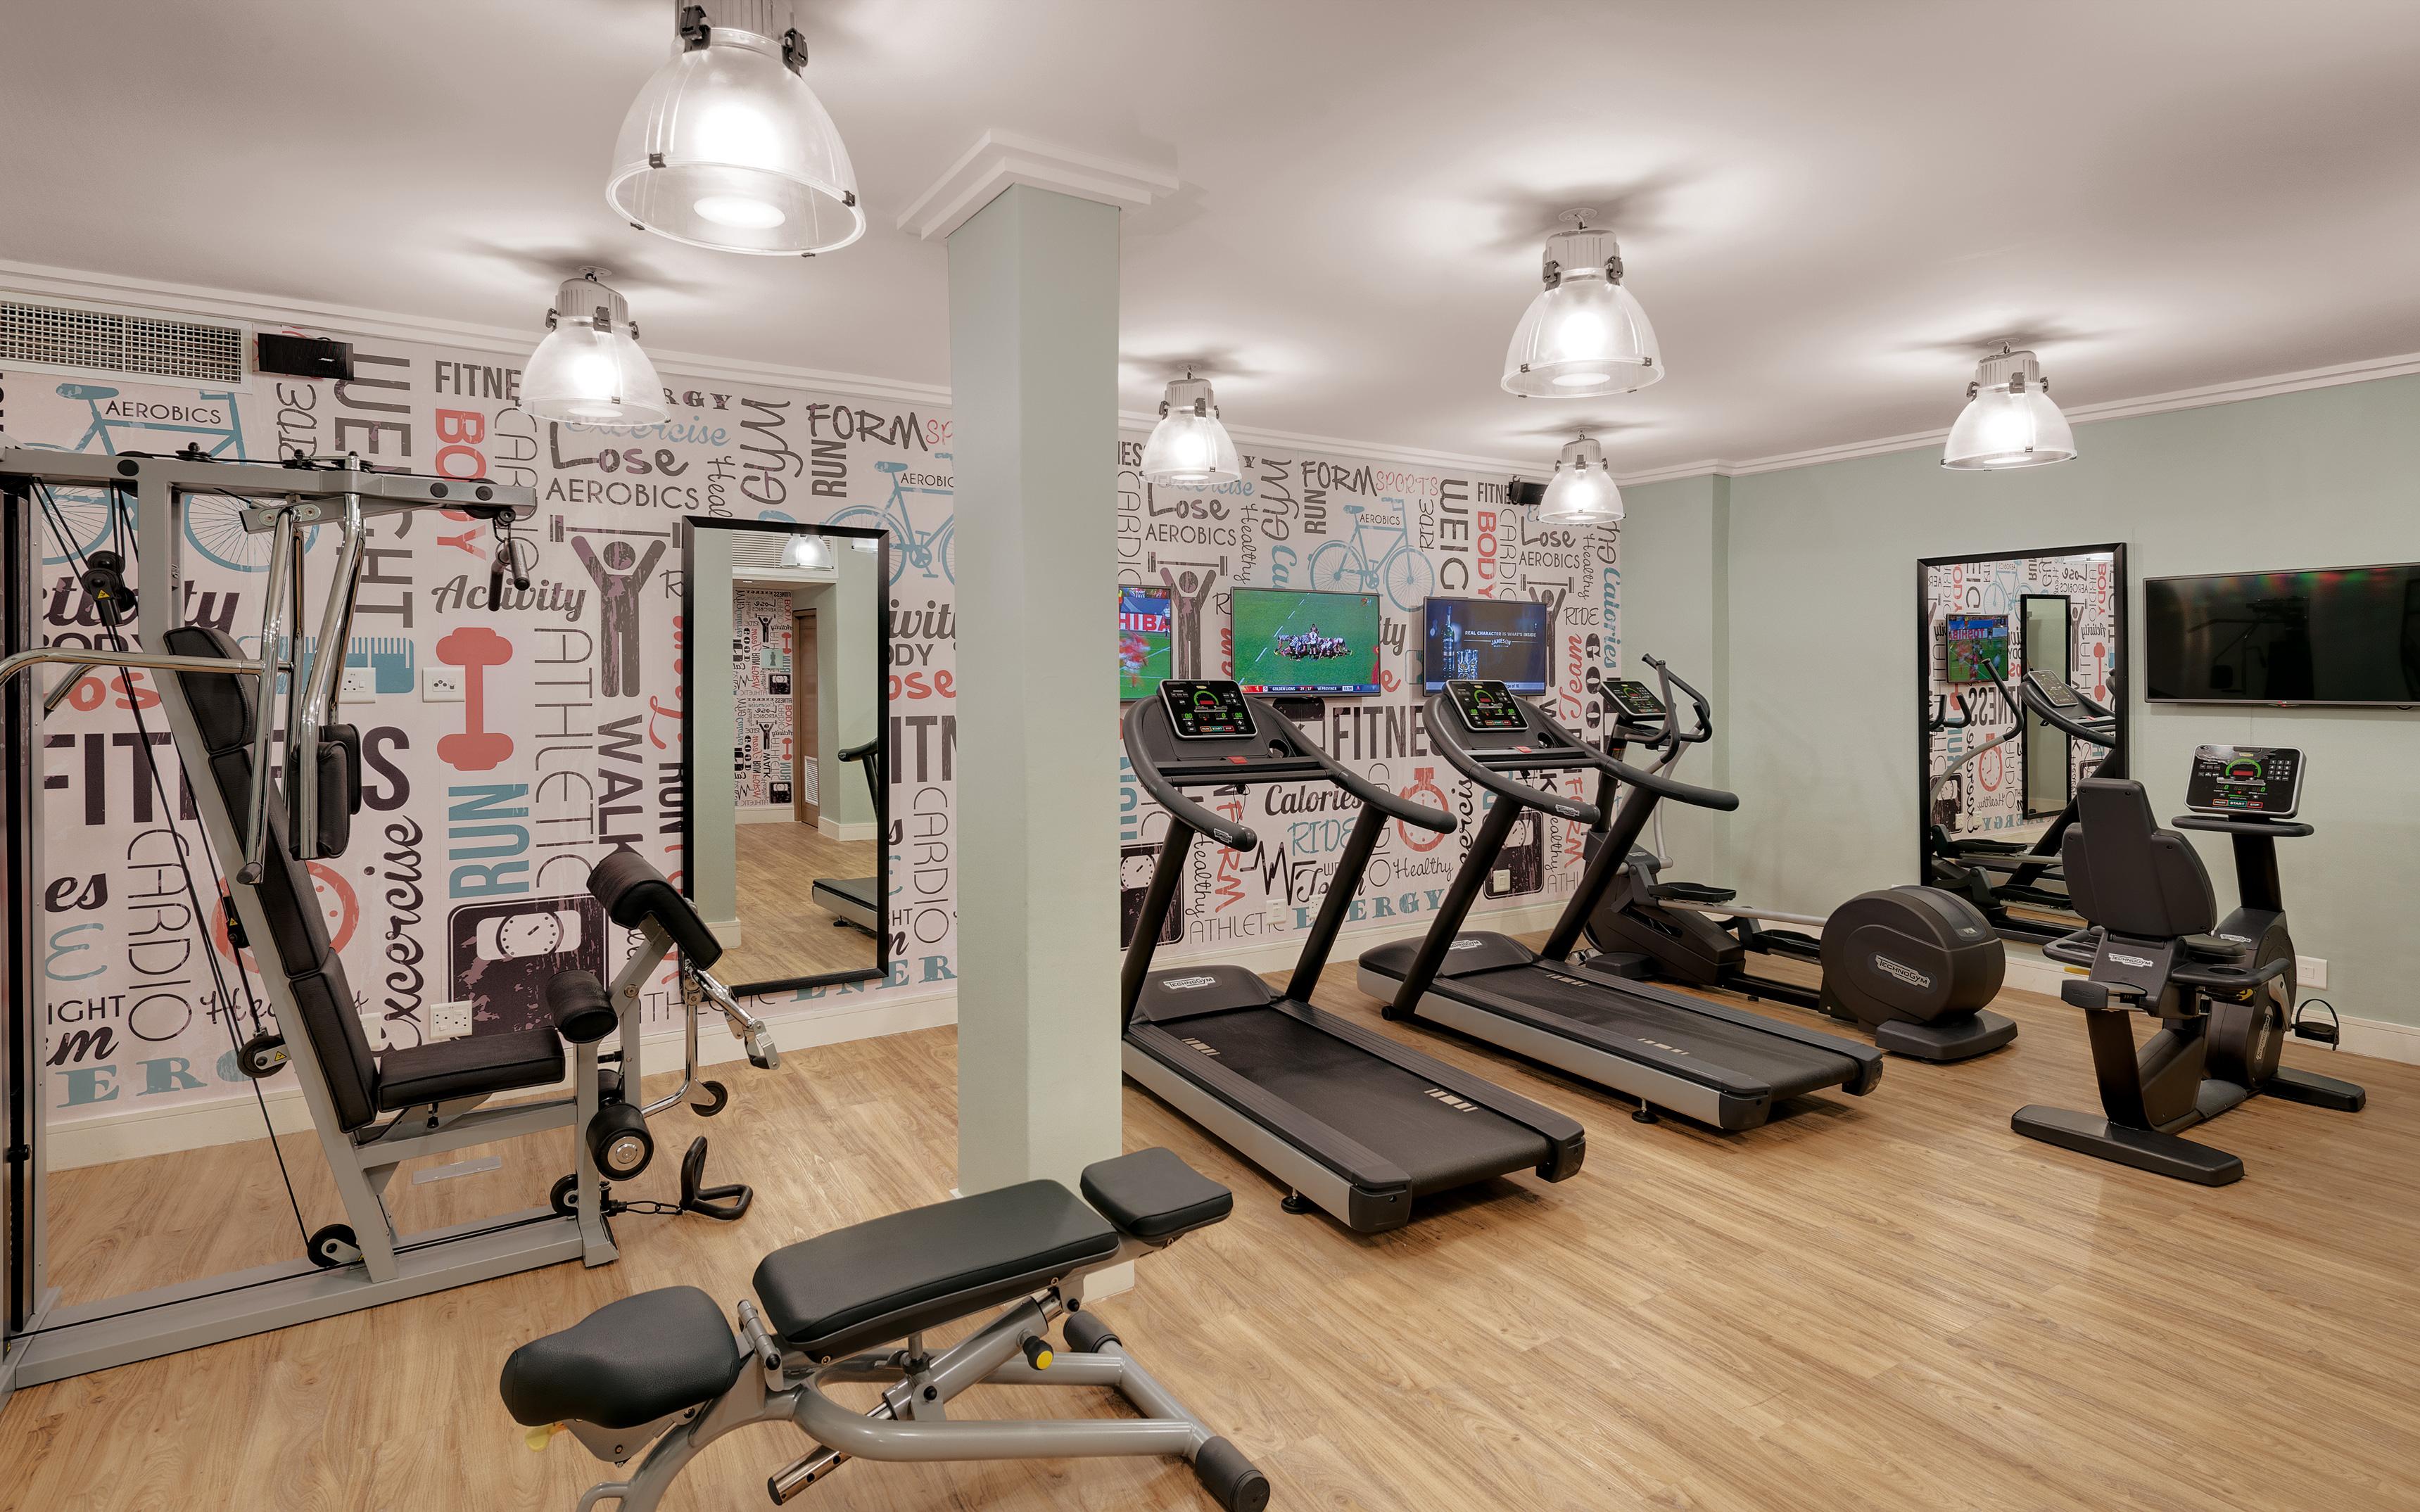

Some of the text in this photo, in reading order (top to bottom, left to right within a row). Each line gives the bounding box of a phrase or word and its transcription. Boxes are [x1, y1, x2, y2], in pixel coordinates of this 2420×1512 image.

[436, 360, 522, 407] FITNE
[105, 400, 222, 425] AEROBICS
[806, 402, 928, 452] FORM
[550, 421, 690, 477] Lose
[811, 439, 847, 498] RUN
[334, 352, 414, 628] WEHT
[435, 407, 487, 561] BOY
[494, 406, 540, 573] CARIO
[545, 477, 699, 511] AEROBICS
[707, 455, 737, 518] Heal
[900, 472, 954, 488] AEROBIC
[1147, 481, 1231, 520] Lose
[1300, 460, 1378, 497] FORM
[1374, 470, 1439, 497] SPORTS
[1477, 481, 1521, 505] FITNE
[1145, 523, 1237, 547] AEROBICS
[1303, 489, 1327, 535] RUN
[1359, 513, 1401, 526] AEROBICS
[1419, 497, 1435, 552] RIDE
[1520, 516, 1576, 548] Lose
[1233, 502, 1259, 585] Healthy
[1439, 478, 1469, 598] WEIG
[1477, 511, 1497, 599] BODY
[1519, 551, 1580, 570] AEROBICS
[1577, 533, 1597, 601] Healthy
[431, 574, 587, 623] Acivity
[1562, 606, 1600, 628] RIDE
[1602, 566, 1621, 669] Calories
[1119, 613, 1171, 632] HIBA
[888, 669, 957, 701] ose
[1558, 633, 1583, 721] Team
[1332, 706, 1442, 761] FITNE
[534, 628, 595, 889] ATHLETIC
[1265, 783, 1363, 816] Calories
[448, 782, 530, 899] RUN
[1215, 799, 1246, 914] FRM
[1545, 817, 1563, 872] ealthy
[913, 787, 949, 944] CARDIO
[1393, 856, 1453, 882] Healthy
[1293, 888, 1443, 930] EERGY
[127, 828, 192, 1042] CARDIO
[1164, 976, 1215, 989] TECHNOGYM
[1876, 955, 1930, 988] TECHNOGYM
[2110, 953, 2153, 967] TECHNOGYM
[47, 995, 127, 1025] IGHT
